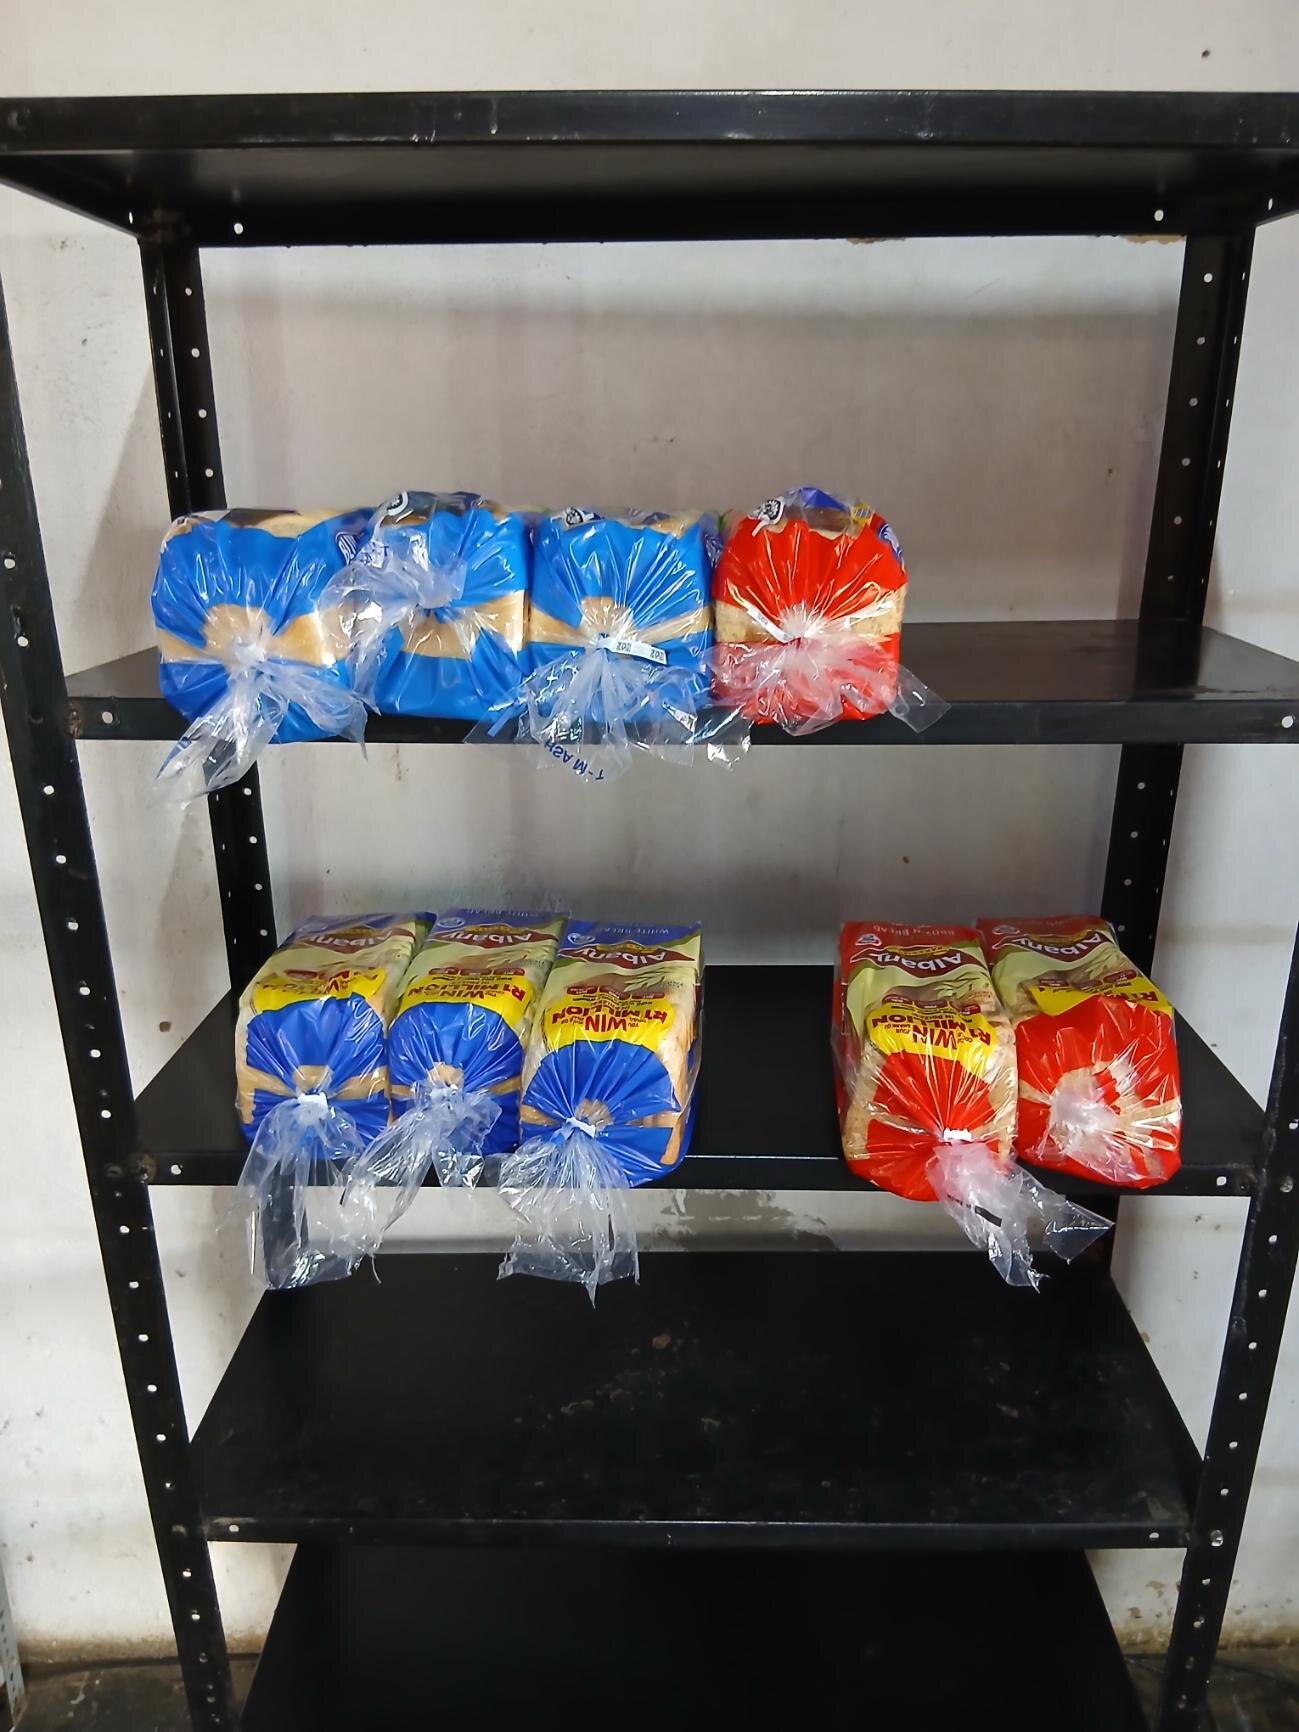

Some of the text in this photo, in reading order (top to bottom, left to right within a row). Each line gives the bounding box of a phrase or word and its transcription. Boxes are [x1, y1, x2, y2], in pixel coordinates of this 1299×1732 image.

[442, 932, 531, 944] Albany
[1011, 933, 1101, 954] Albany
[575, 949, 666, 965] Albany
[869, 953, 961, 970] Albany
[439, 991, 484, 999] WIN
[503, 984, 526, 1001] R1
[552, 1005, 641, 1024] MILLION
[585, 1014, 627, 1032] WIN
[644, 1010, 668, 1024] R1
[871, 1015, 966, 1032] MILLION
[913, 1025, 957, 1050] WIN
